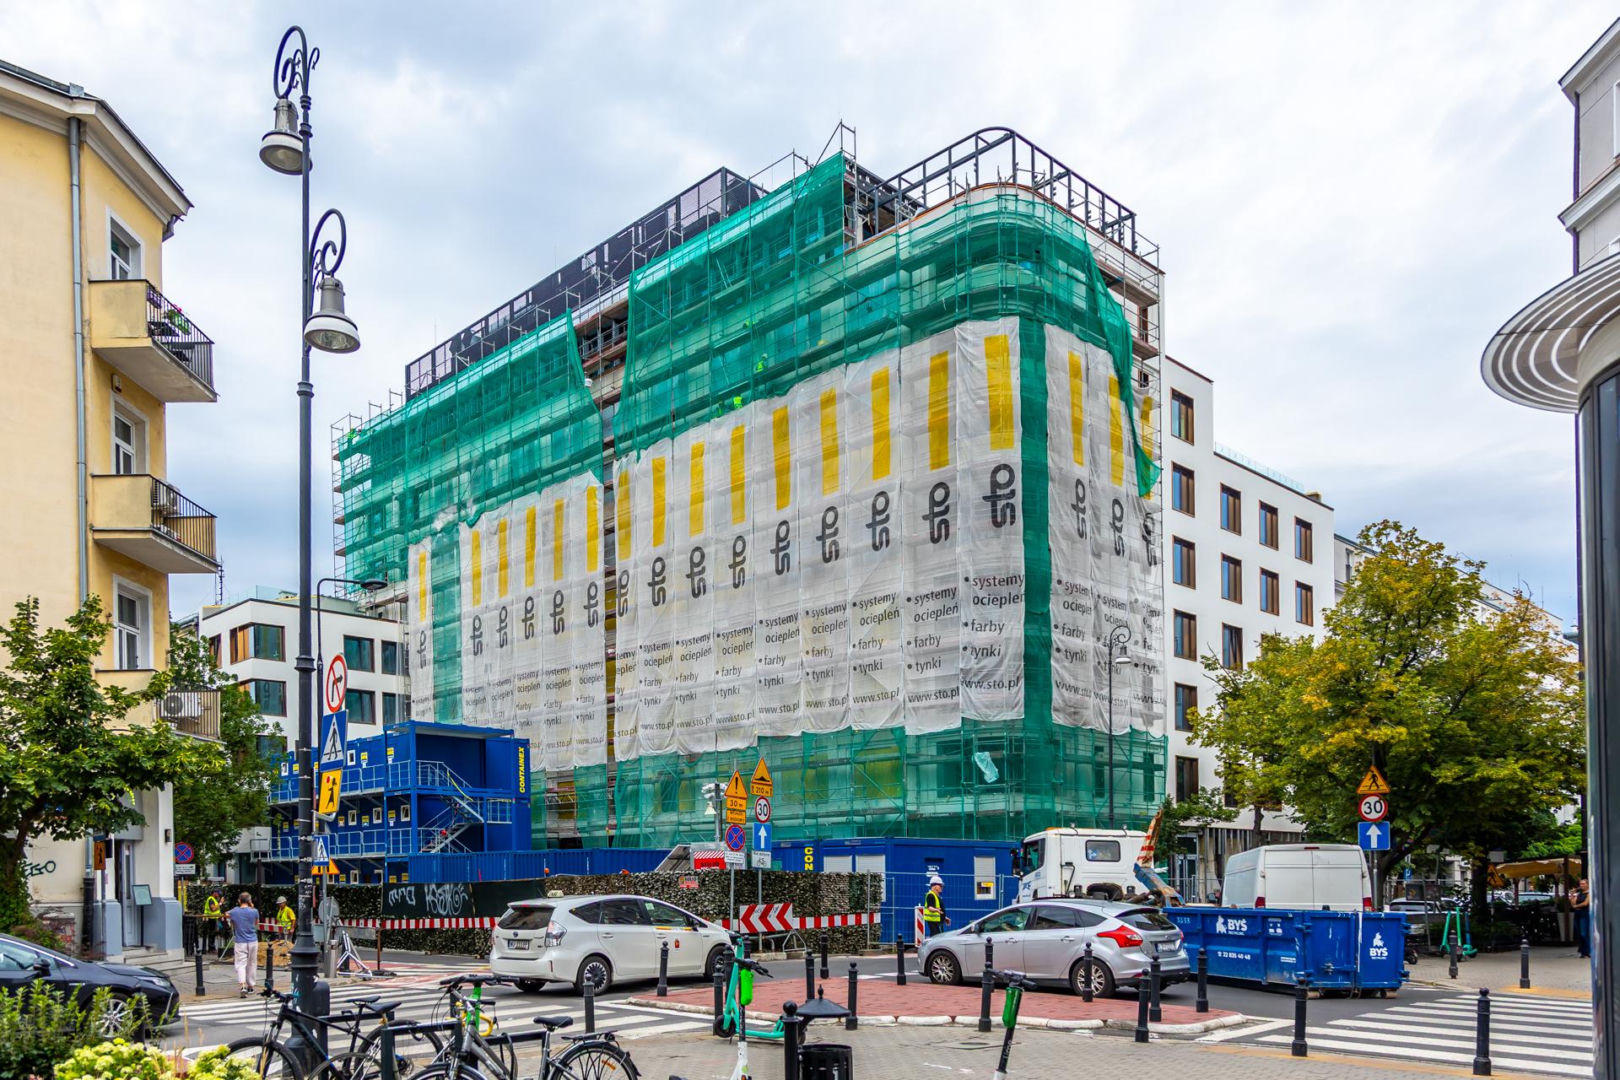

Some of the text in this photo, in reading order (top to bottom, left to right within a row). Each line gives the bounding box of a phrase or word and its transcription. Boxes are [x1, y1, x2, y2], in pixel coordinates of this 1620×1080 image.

[982, 463, 1016, 528] sto
[922, 481, 950, 544] sto
[1071, 478, 1087, 540] sto
[865, 490, 890, 551] sto
[1109, 498, 1125, 557] sto
[815, 506, 839, 563] sto
[769, 519, 791, 576] sto
[728, 535, 747, 589] sto
[685, 546, 706, 599] sto
[648, 556, 666, 607] sto
[972, 574, 1025, 590] systemy
[1065, 581, 1090, 597] system
[616, 569, 630, 617] sto
[860, 592, 897, 611] systemy
[914, 587, 957, 606] systemy
[583, 581, 599, 628] sto
[811, 602, 847, 618] systemy
[1103, 595, 1127, 611] system
[522, 595, 534, 640] sto
[550, 589, 565, 635] sto
[765, 611, 798, 629] systemy
[859, 606, 900, 626] ociepleń
[914, 602, 959, 622] ociepleń
[495, 605, 508, 648] sto
[721, 625, 754, 641] systemy
[970, 619, 1005, 635] farby
[1061, 623, 1085, 642] farby
[470, 614, 483, 657] sto
[681, 632, 711, 649] systemy
[858, 636, 884, 650] farby
[914, 633, 941, 648] farby
[643, 640, 672, 654] systemy
[811, 646, 834, 658] farby
[764, 655, 786, 667] farby
[1064, 648, 1087, 664] tynki
[721, 665, 742, 677] farby
[859, 658, 883, 676] tynki
[915, 656, 942, 674] tynki
[1103, 660, 1121, 675] tnki
[644, 677, 662, 688] farby
[680, 672, 699, 683] farby
[764, 675, 784, 689] tynki
[812, 666, 834, 683] tynki
[679, 690, 697, 704] tynki
[720, 685, 740, 699] tynki
[806, 692, 849, 708] www.sto.pl
[853, 687, 900, 704] www.sto.pl
[908, 686, 960, 703] www.sto.pl
[644, 695, 661, 707] tynki
[759, 700, 800, 714] www.sto.pl
[756, 786, 765, 794] 210
[757, 803, 769, 816] 30
[1363, 800, 1383, 815] 30
[1227, 918, 1247, 931] BYŚ
